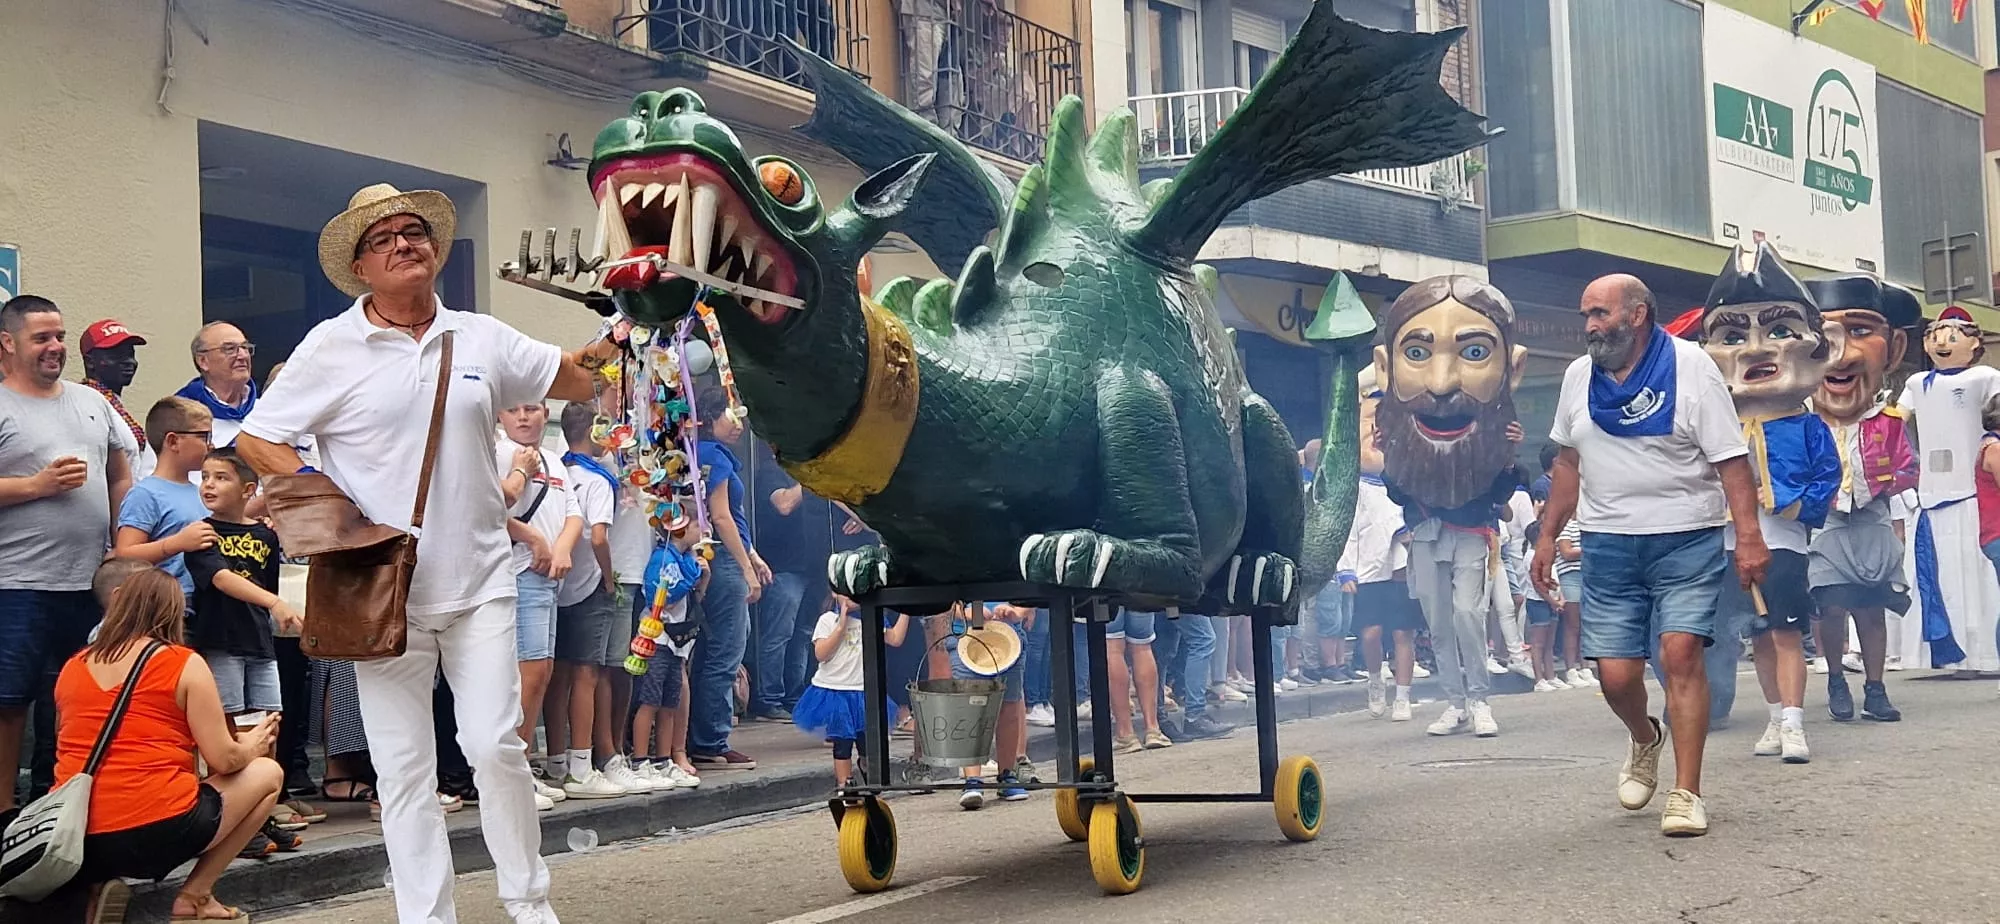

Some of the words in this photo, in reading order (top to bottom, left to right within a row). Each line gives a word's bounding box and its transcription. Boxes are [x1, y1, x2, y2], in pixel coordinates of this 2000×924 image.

[1740, 96, 1774, 151] AA
[1818, 105, 1861, 211] 175
[1830, 173, 1855, 194] AÑOS
